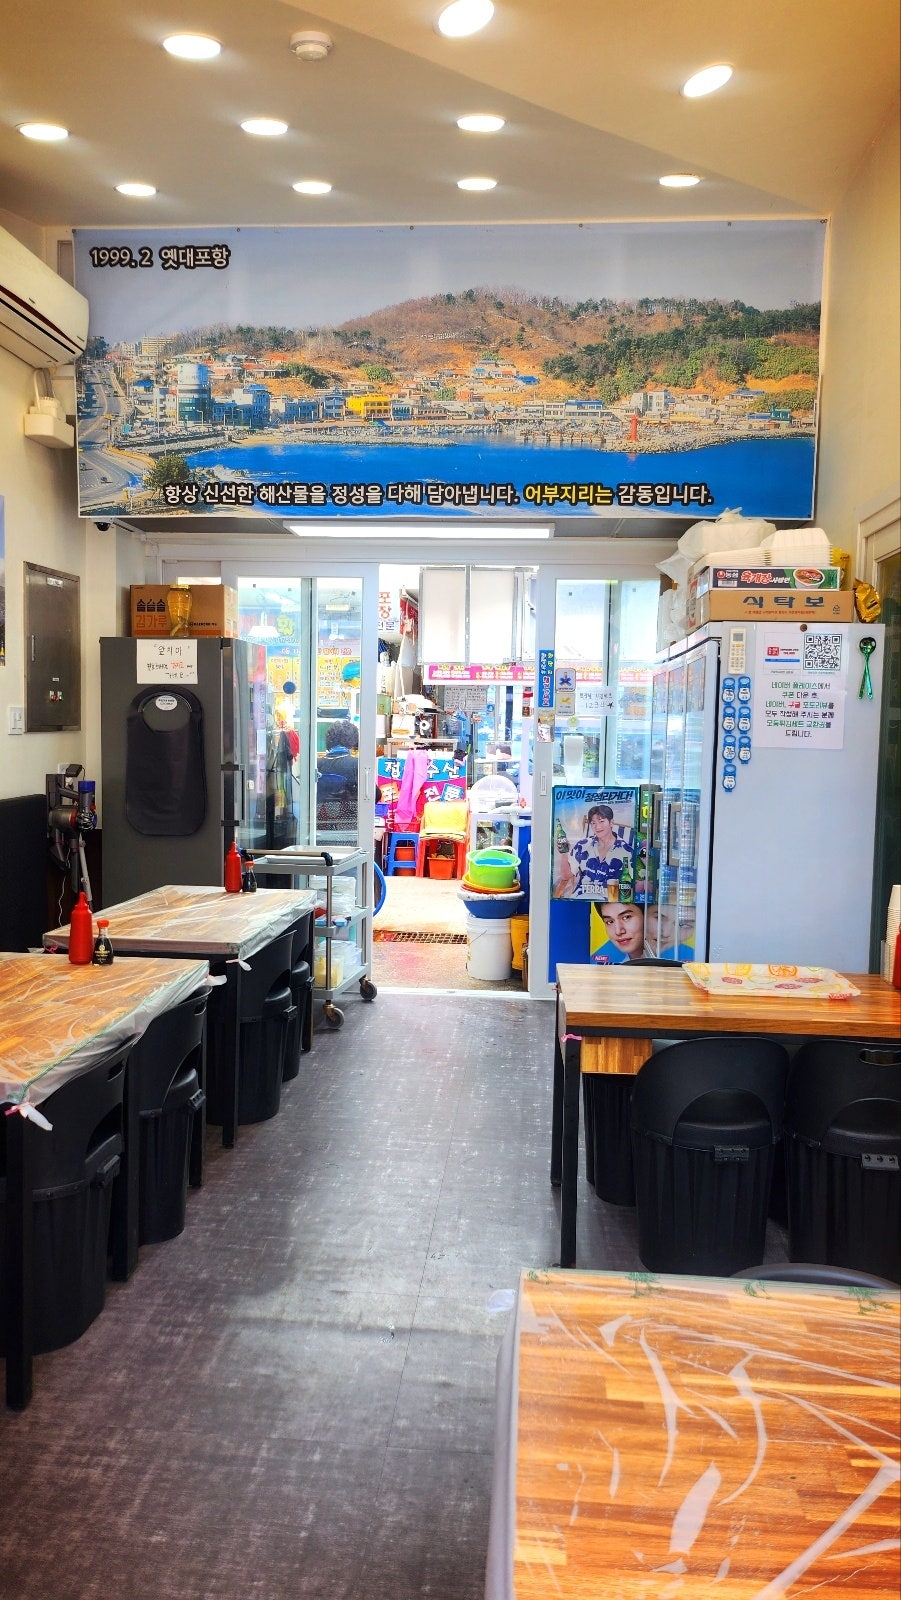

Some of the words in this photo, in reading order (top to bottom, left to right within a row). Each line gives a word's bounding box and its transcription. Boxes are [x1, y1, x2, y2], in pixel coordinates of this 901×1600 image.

[160, 246, 230, 269] 옛대포항
[165, 484, 198, 505] 항상
[203, 484, 254, 505] 신선한
[258, 484, 327, 505] 해산물을
[331, 484, 383, 505] 정성을
[386, 484, 422, 504] 다해
[426, 484, 520, 505] 담아냅니다.
[524, 484, 614, 506] 어부지리는
[618, 484, 714, 506] 감동입니다.
[741, 570, 772, 584] 육개장
[743, 596, 824, 608] 식탁보
[135, 614, 167, 628] 김가루
[771, 681, 791, 689] 네이버
[796, 691, 809, 699] 다운
[788, 701, 801, 709] 구글
[765, 710, 778, 718] 모두
[800, 711, 820, 719] 주시는
[785, 729, 813, 738] 드립니다.
[580, 884, 605, 894] TERRA
